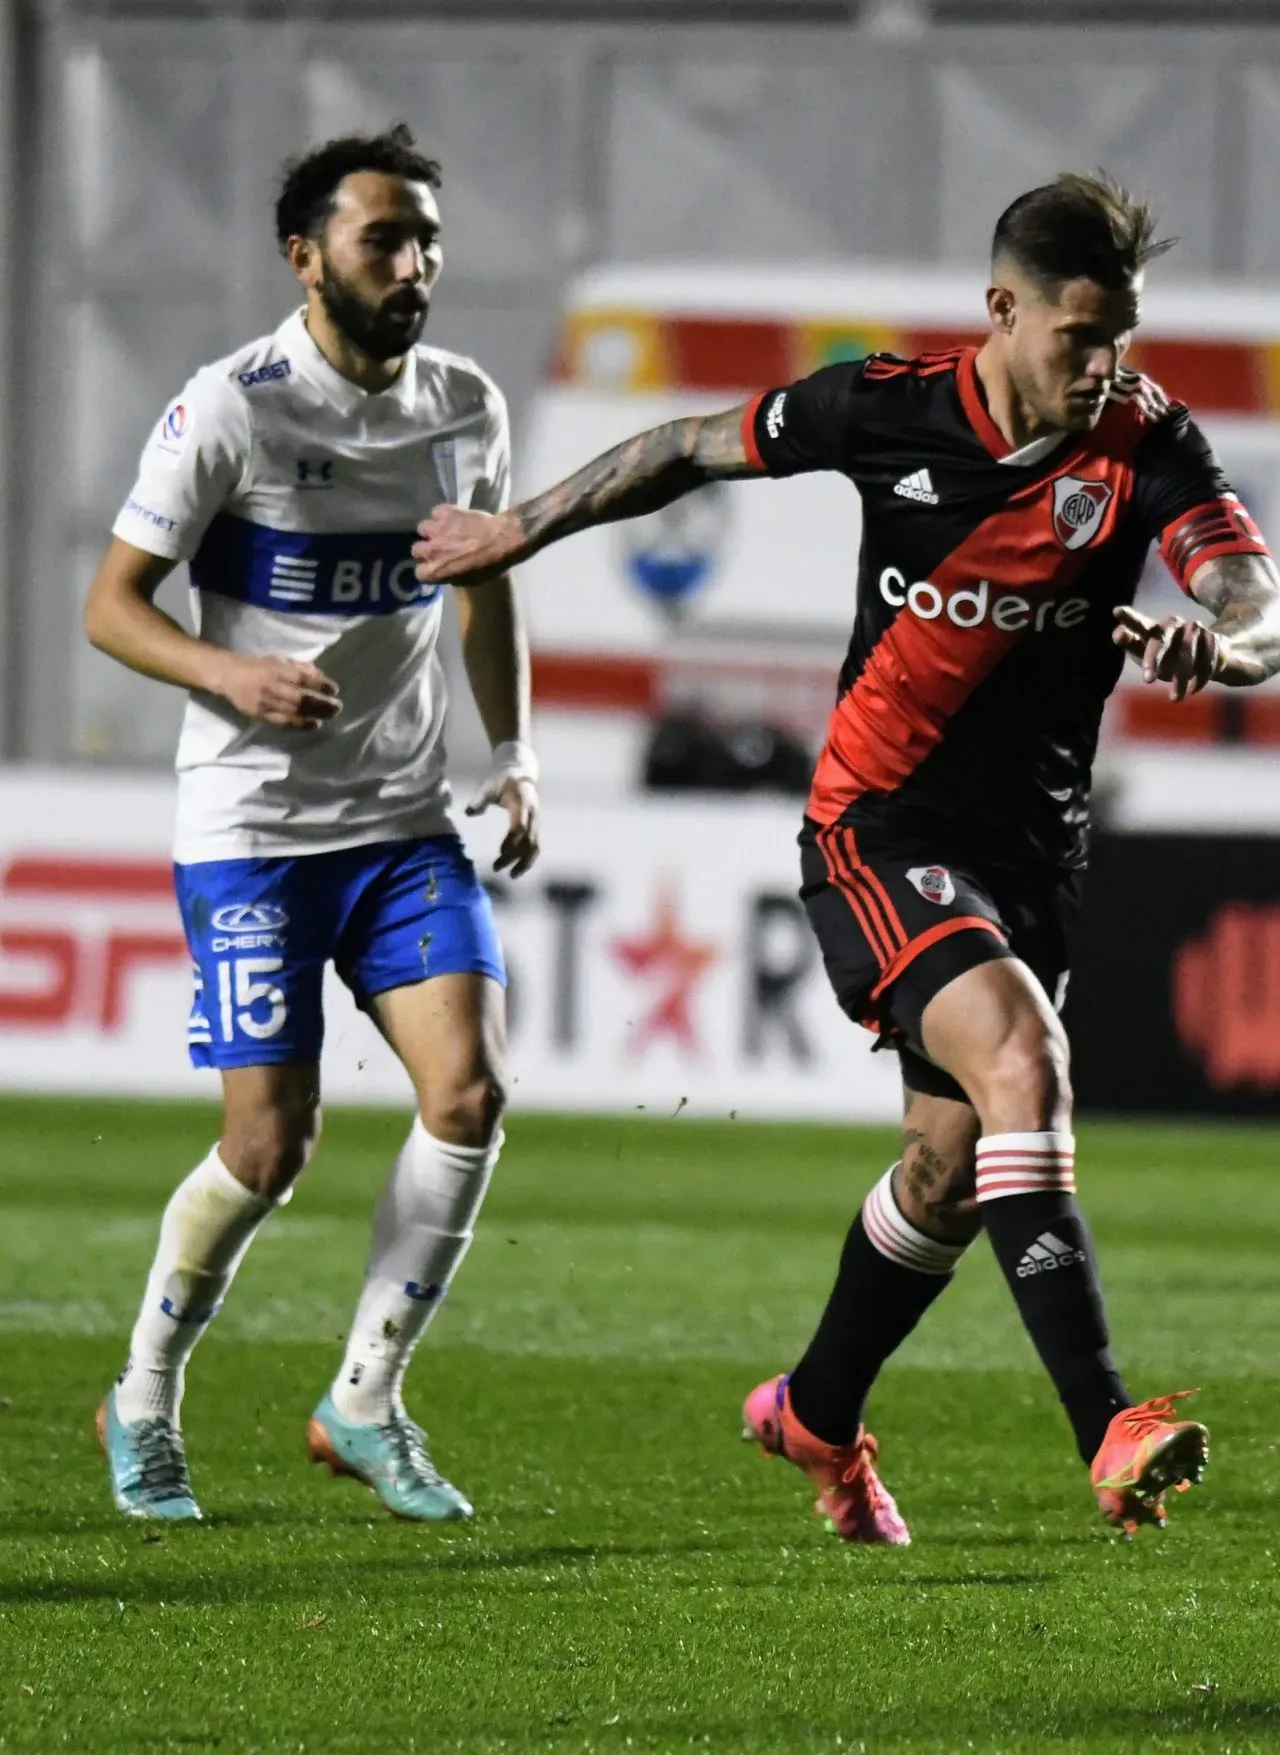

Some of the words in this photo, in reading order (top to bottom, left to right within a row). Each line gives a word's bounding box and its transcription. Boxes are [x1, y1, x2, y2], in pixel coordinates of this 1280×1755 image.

[894, 484, 940, 504] adidas
[331, 559, 434, 602] BIC
[879, 566, 1090, 633] codere
[212, 933, 288, 953] CHERY
[217, 956, 288, 1043] 15
[1016, 1250, 1088, 1278] adidas
